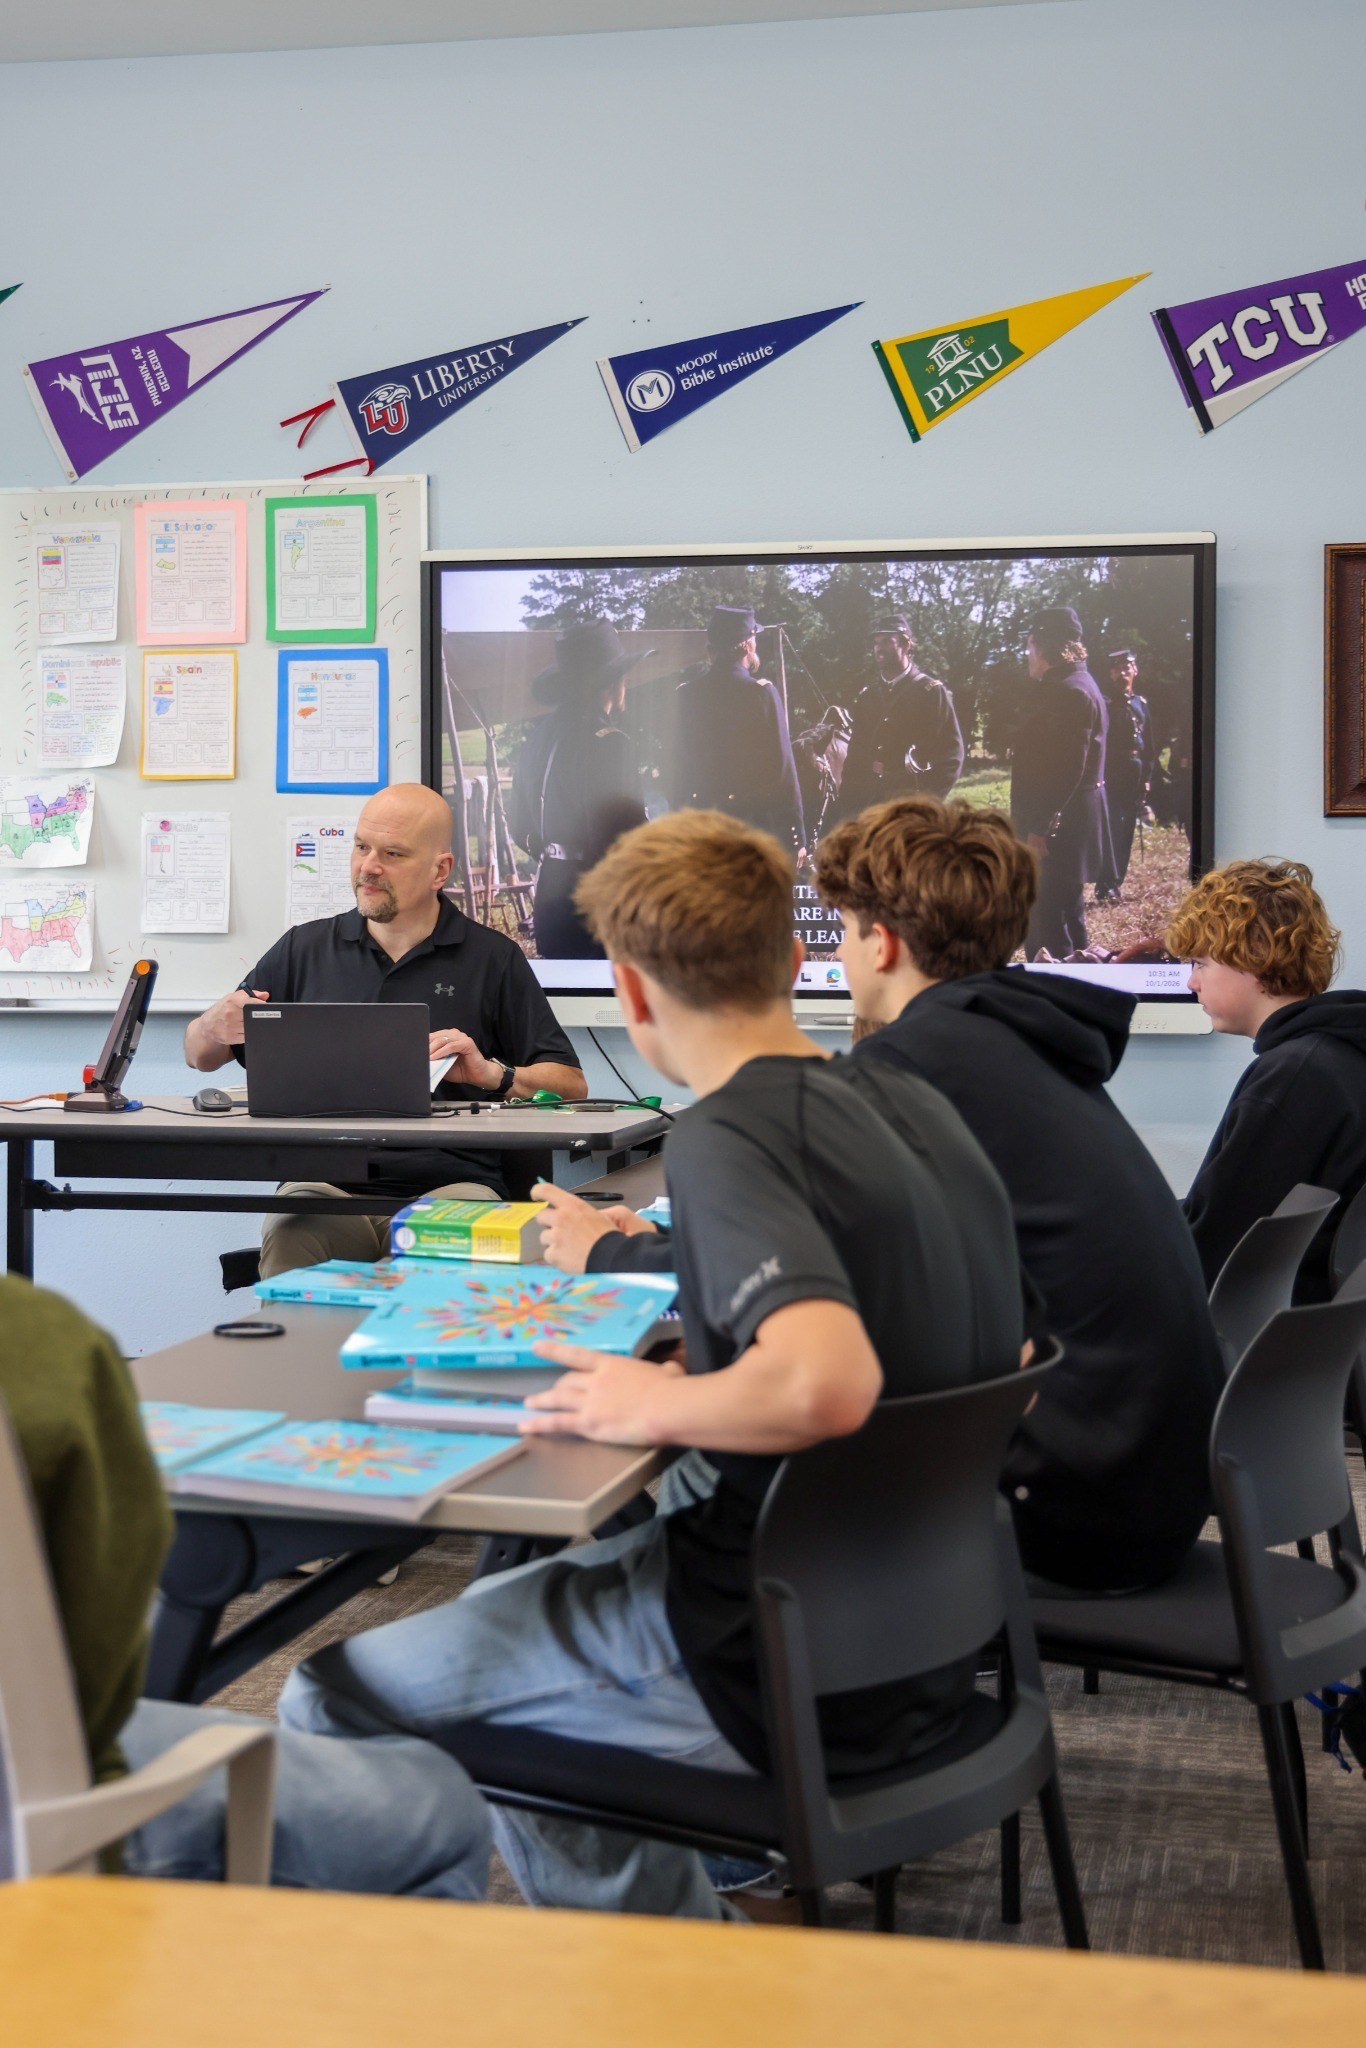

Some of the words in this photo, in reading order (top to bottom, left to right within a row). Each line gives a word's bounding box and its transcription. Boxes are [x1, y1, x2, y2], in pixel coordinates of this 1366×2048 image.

[131, 345, 144, 361] AZ
[675, 350, 718, 375] MOODY
[925, 364, 936, 374] 19
[963, 335, 975, 347] 02
[1185, 291, 1329, 393] TCU
[138, 360, 162, 407] PHOENIX,
[146, 349, 171, 393] GCU.EDU
[411, 340, 516, 402] LIBERTY
[437, 363, 506, 408] UNIVERSITY
[680, 368, 716, 391] Bible
[718, 344, 774, 376] Institute
[924, 343, 1003, 413] PLNU
[80, 353, 140, 431] GCU
[176, 665, 203, 676] Spain
[319, 827, 345, 837] Cuba
